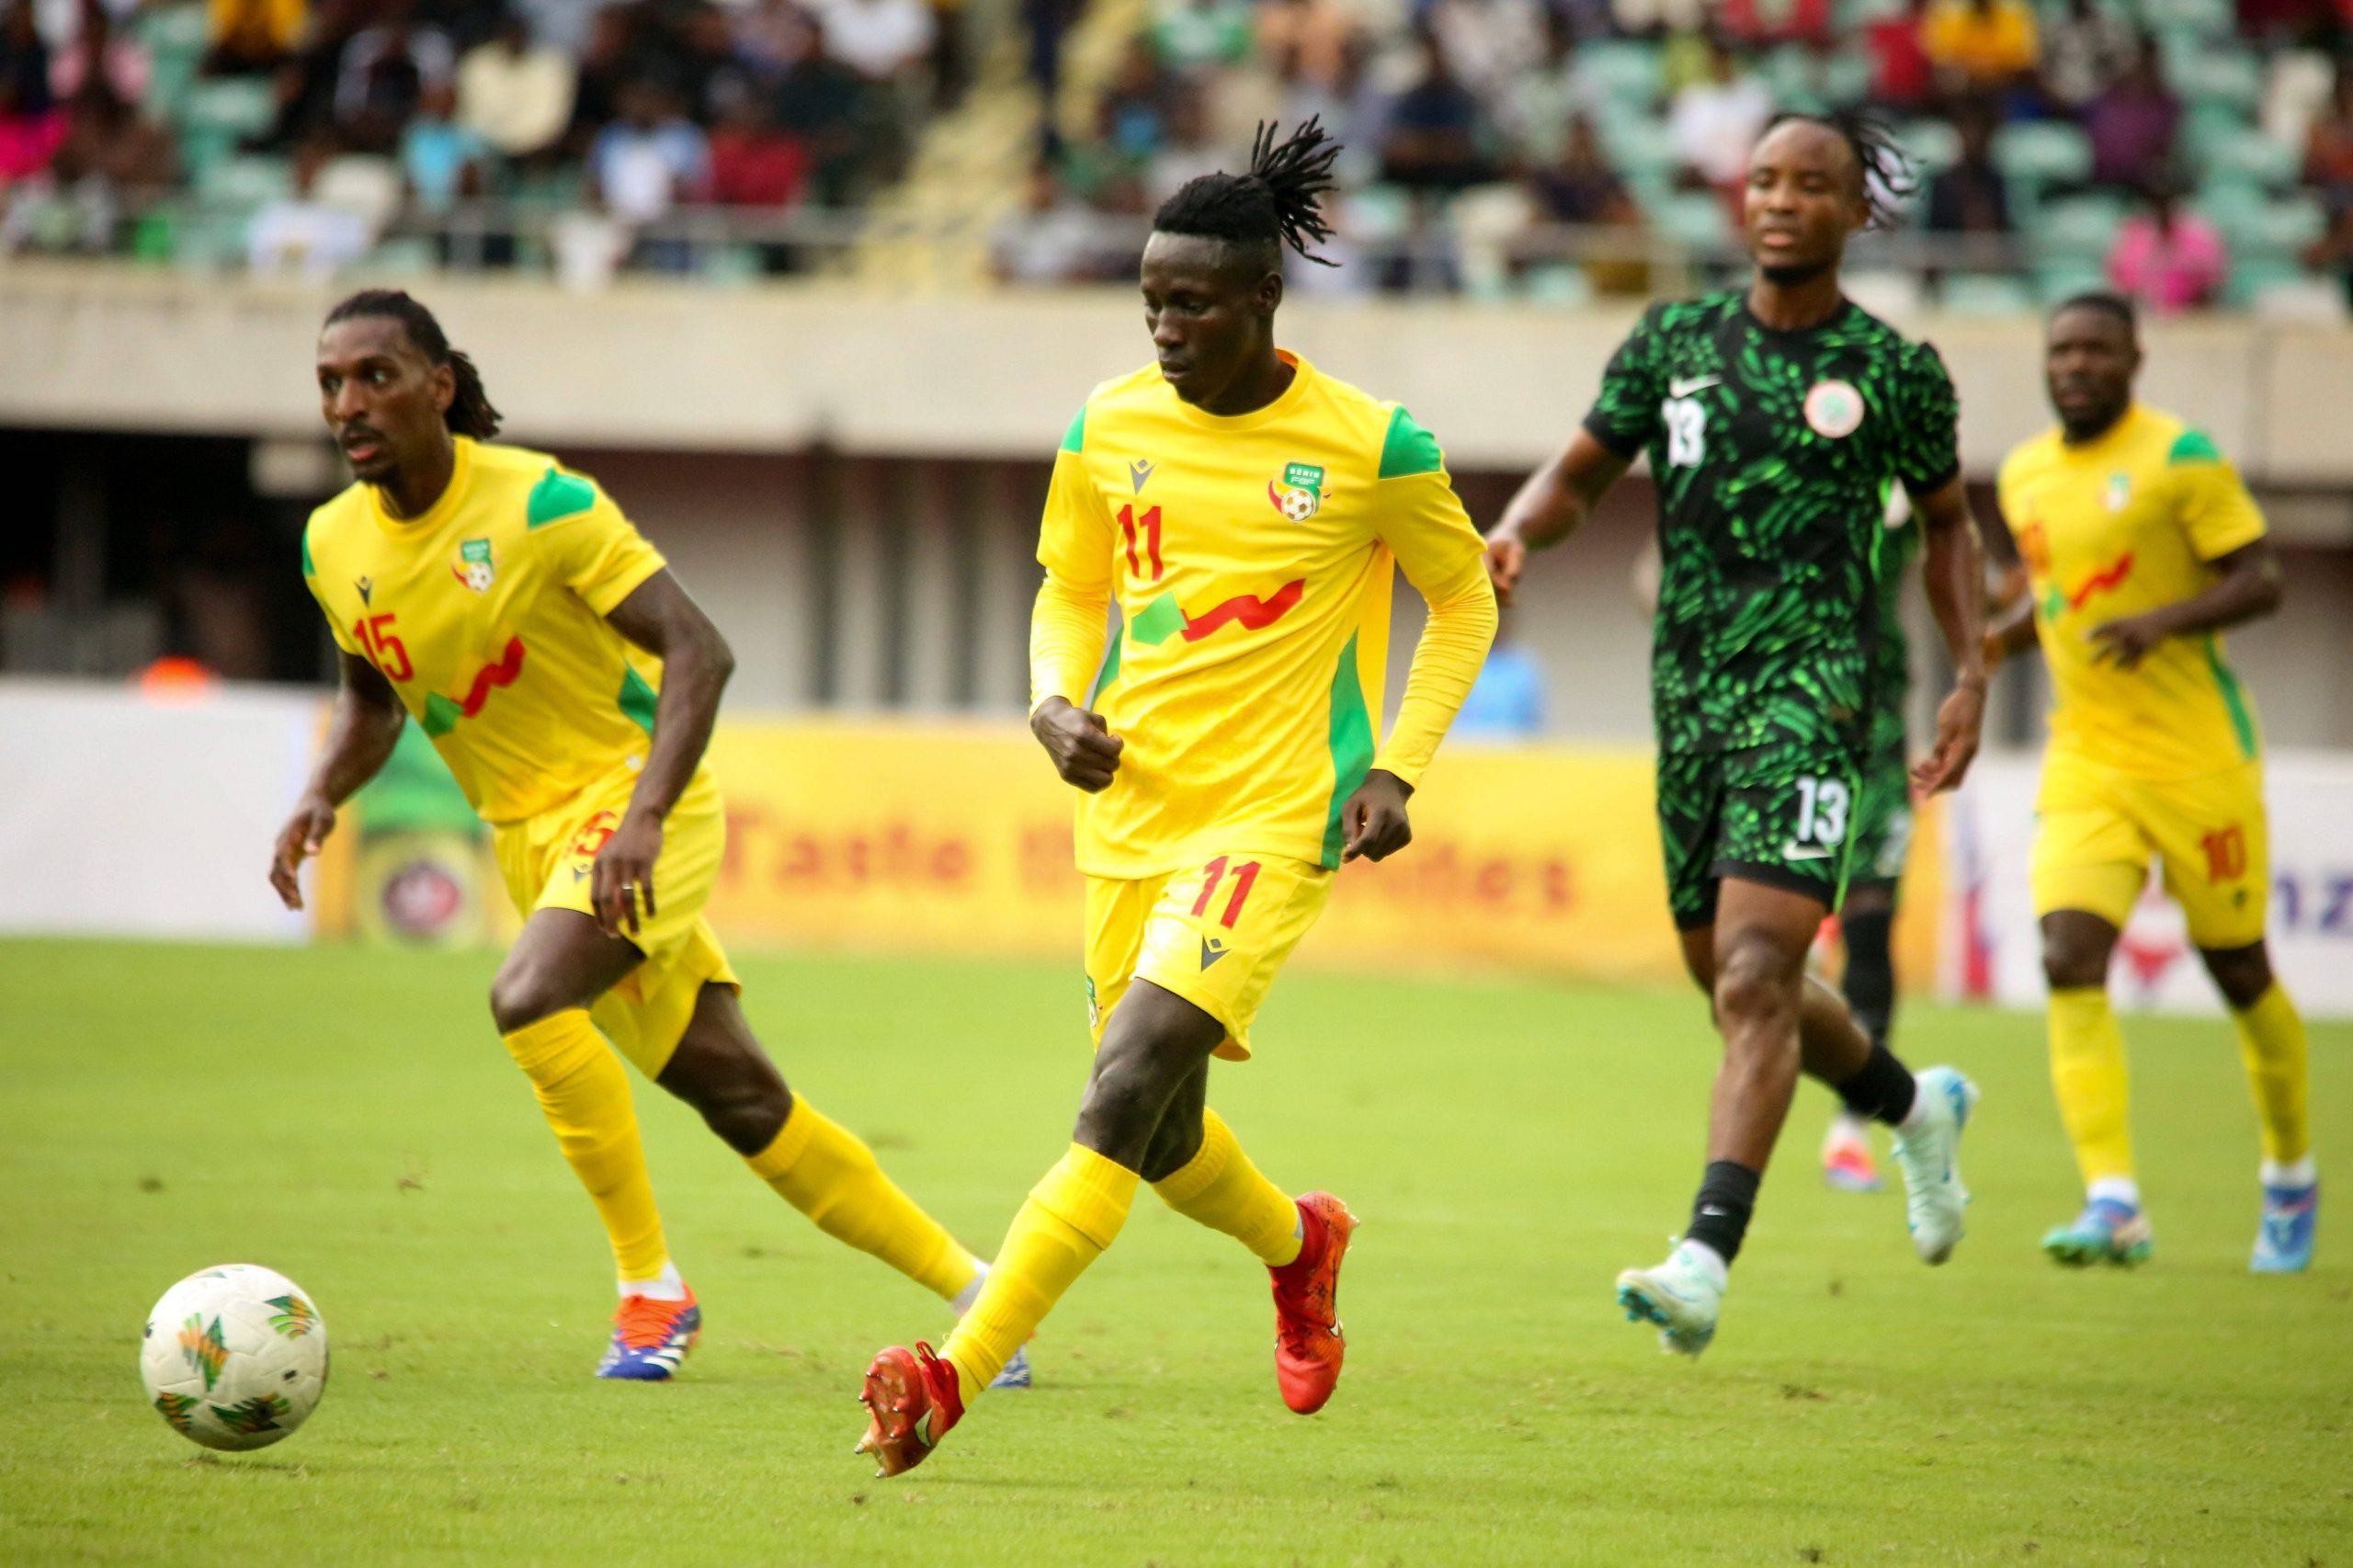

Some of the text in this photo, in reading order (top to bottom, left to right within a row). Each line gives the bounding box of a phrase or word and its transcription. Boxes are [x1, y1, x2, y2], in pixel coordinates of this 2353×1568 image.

[1662, 397, 1708, 468] 13
[1116, 504, 1165, 582] 11
[353, 612, 415, 682] 15
[1795, 775, 1850, 846] 13
[2198, 824, 2248, 887] 10
[1189, 855, 1263, 931] 11
